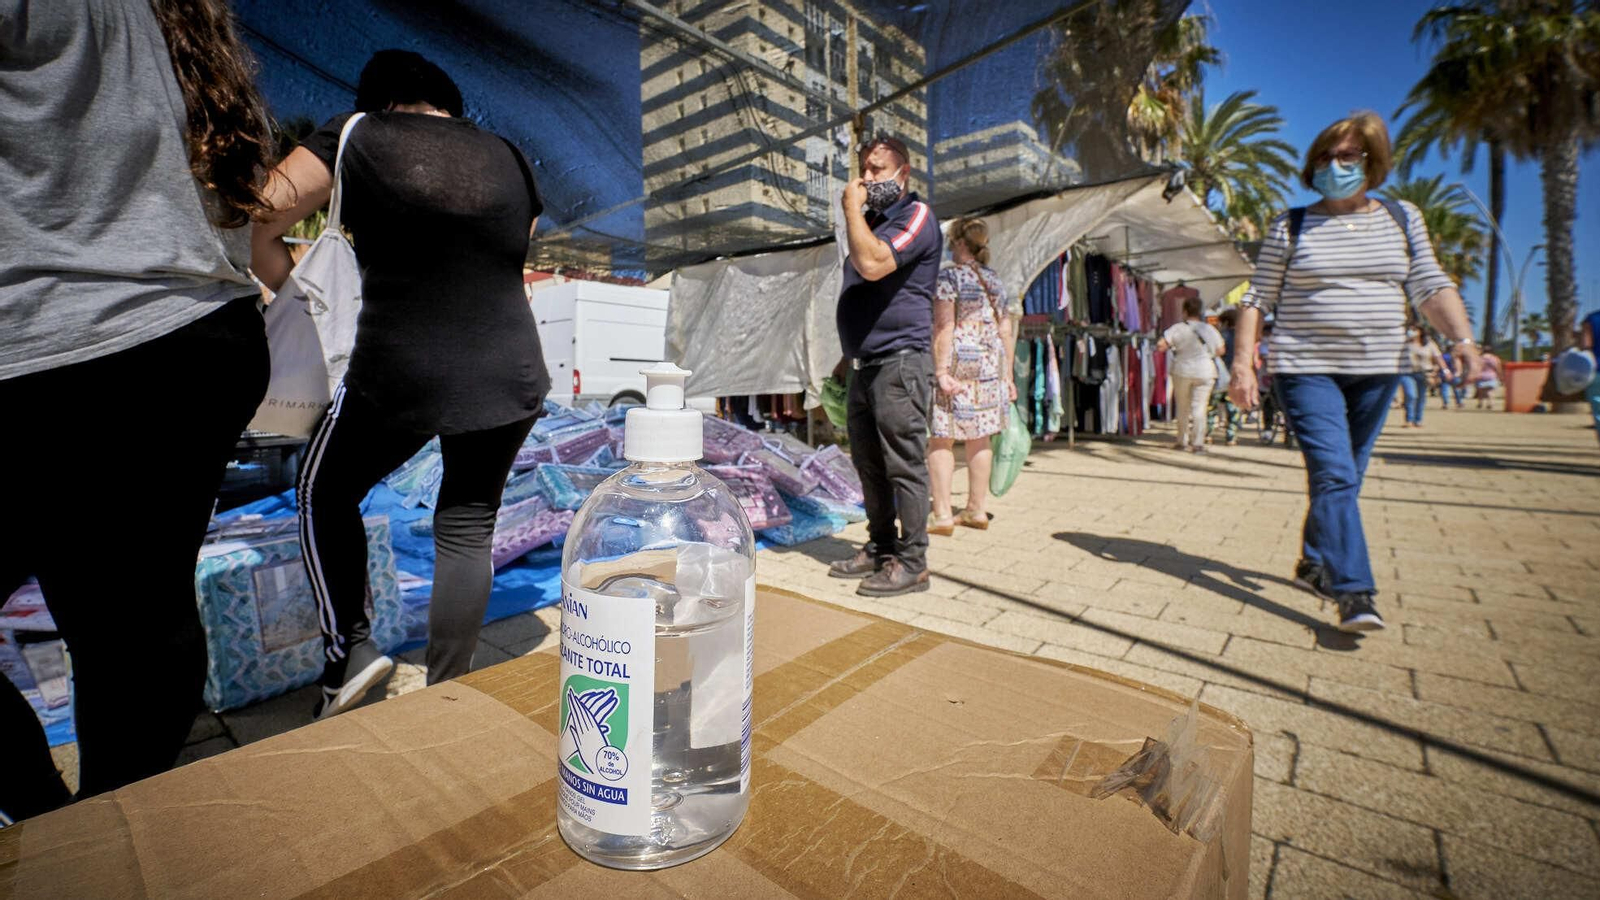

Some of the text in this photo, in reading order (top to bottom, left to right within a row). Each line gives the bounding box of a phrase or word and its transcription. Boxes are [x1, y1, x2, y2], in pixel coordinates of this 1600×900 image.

[264, 397, 325, 409] RIMARK
[586, 657, 631, 679] TOTAL
[603, 750, 620, 761] 70%
[599, 766, 623, 776] ALCOHOL
[582, 781, 596, 796] SIN
[597, 787, 625, 802] AGUA
